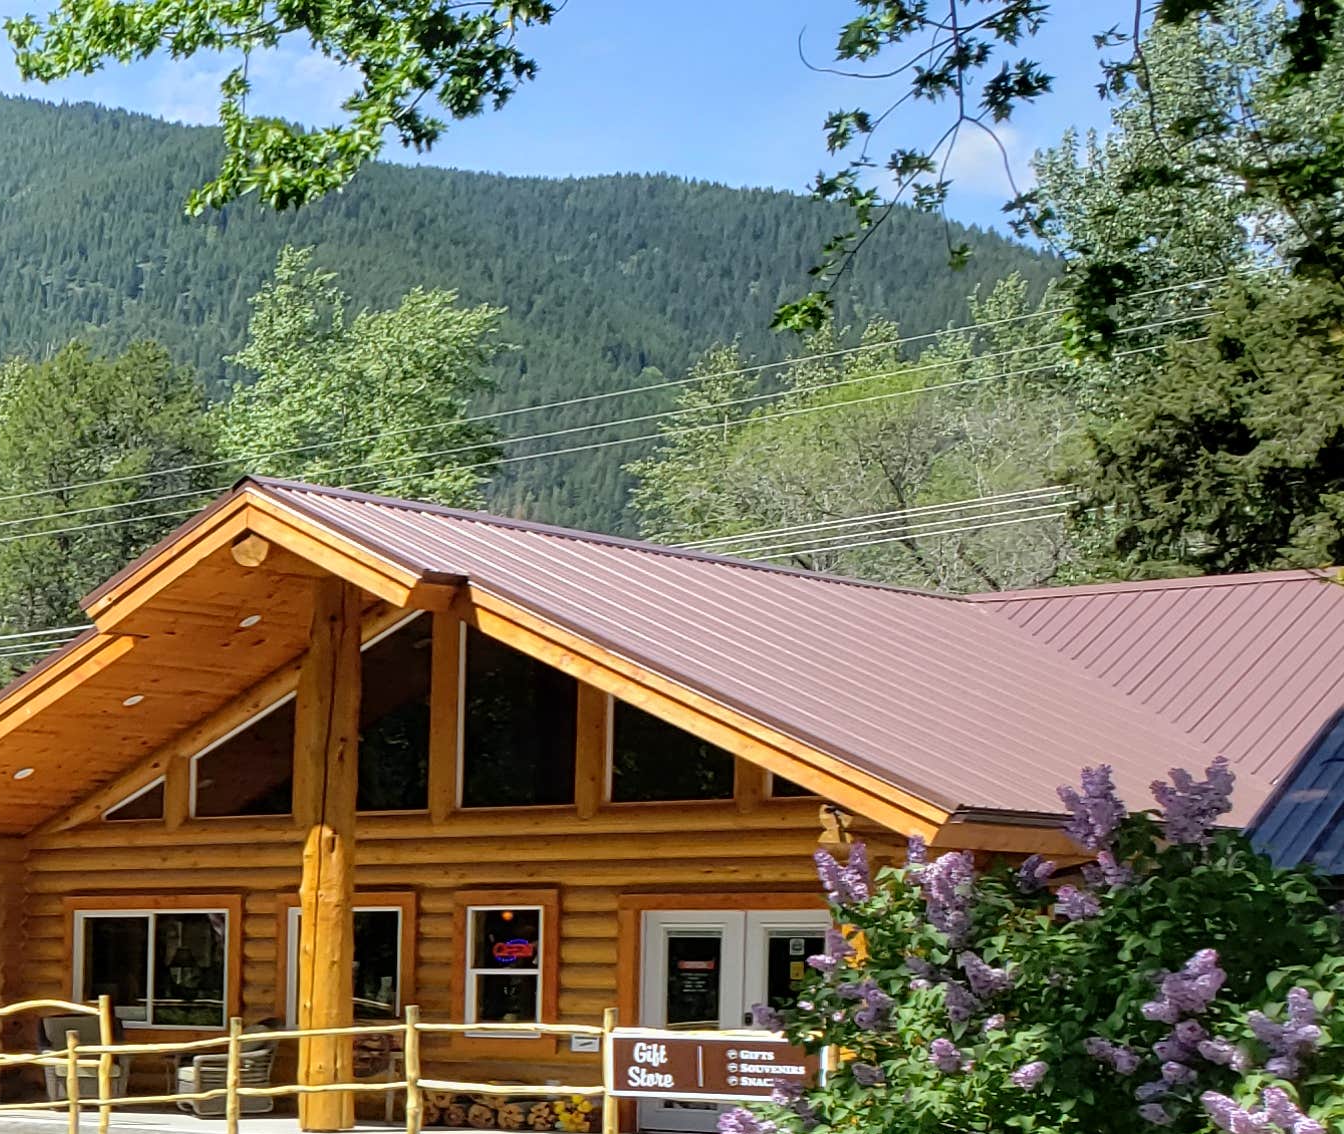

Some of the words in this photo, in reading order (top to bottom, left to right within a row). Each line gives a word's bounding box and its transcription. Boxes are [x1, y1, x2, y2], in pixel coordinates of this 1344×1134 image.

[632, 1042, 668, 1067] Gift
[627, 1065, 675, 1088] Store
[739, 1076, 775, 1087] SNAC
